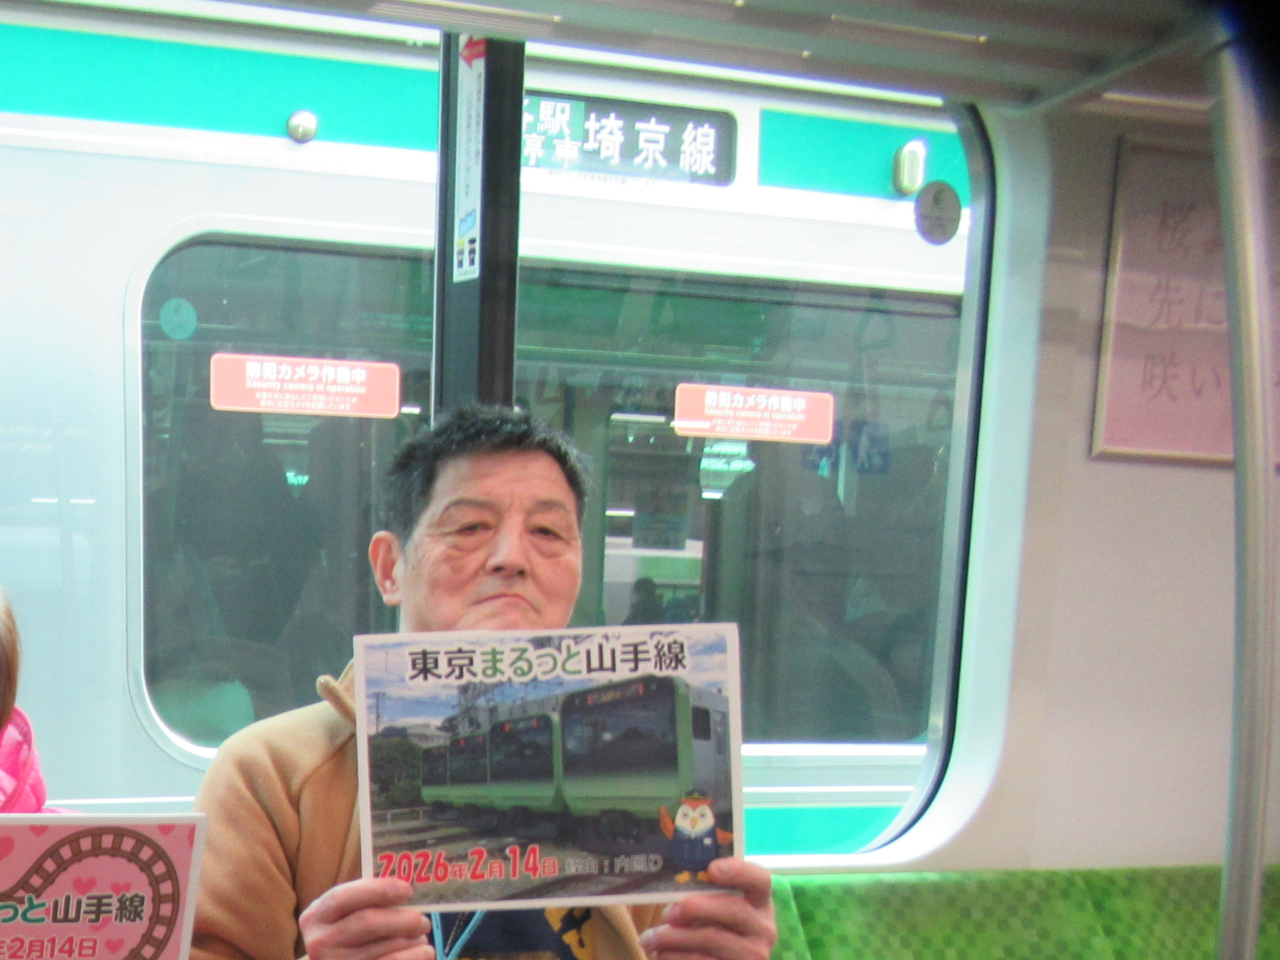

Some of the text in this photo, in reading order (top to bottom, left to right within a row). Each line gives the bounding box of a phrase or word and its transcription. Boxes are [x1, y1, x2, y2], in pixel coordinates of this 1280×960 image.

[583, 111, 718, 176] 埼京線
[245, 361, 367, 384] 防犯カメラ作動中
[704, 390, 807, 412] 防犯カメラ作動中
[407, 638, 688, 681] 東京まるっと山手線
[378, 845, 559, 883] 2026年2月14日
